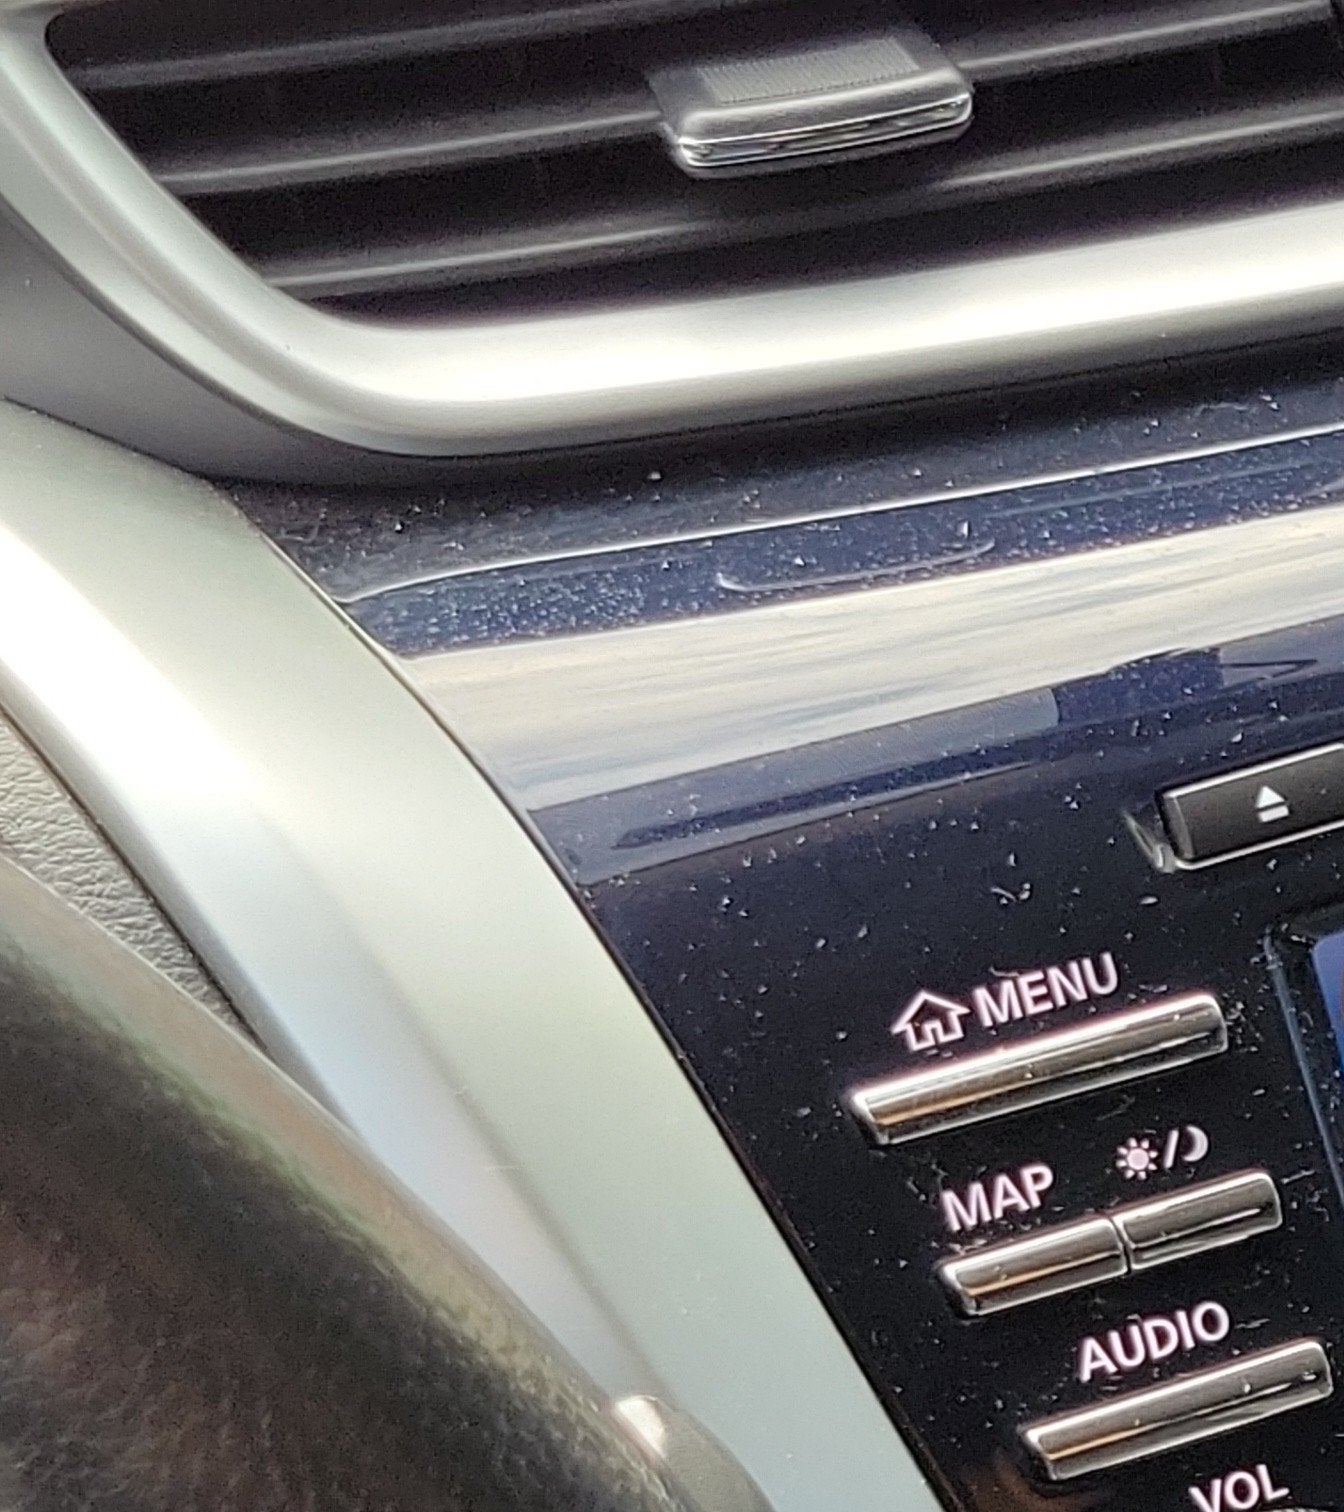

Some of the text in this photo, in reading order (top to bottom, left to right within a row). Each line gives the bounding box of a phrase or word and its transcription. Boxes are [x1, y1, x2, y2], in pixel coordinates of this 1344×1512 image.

[972, 952, 1120, 1029] MENU
[940, 1163, 1055, 1233] MAP
[1077, 1301, 1231, 1383] AUDIO
